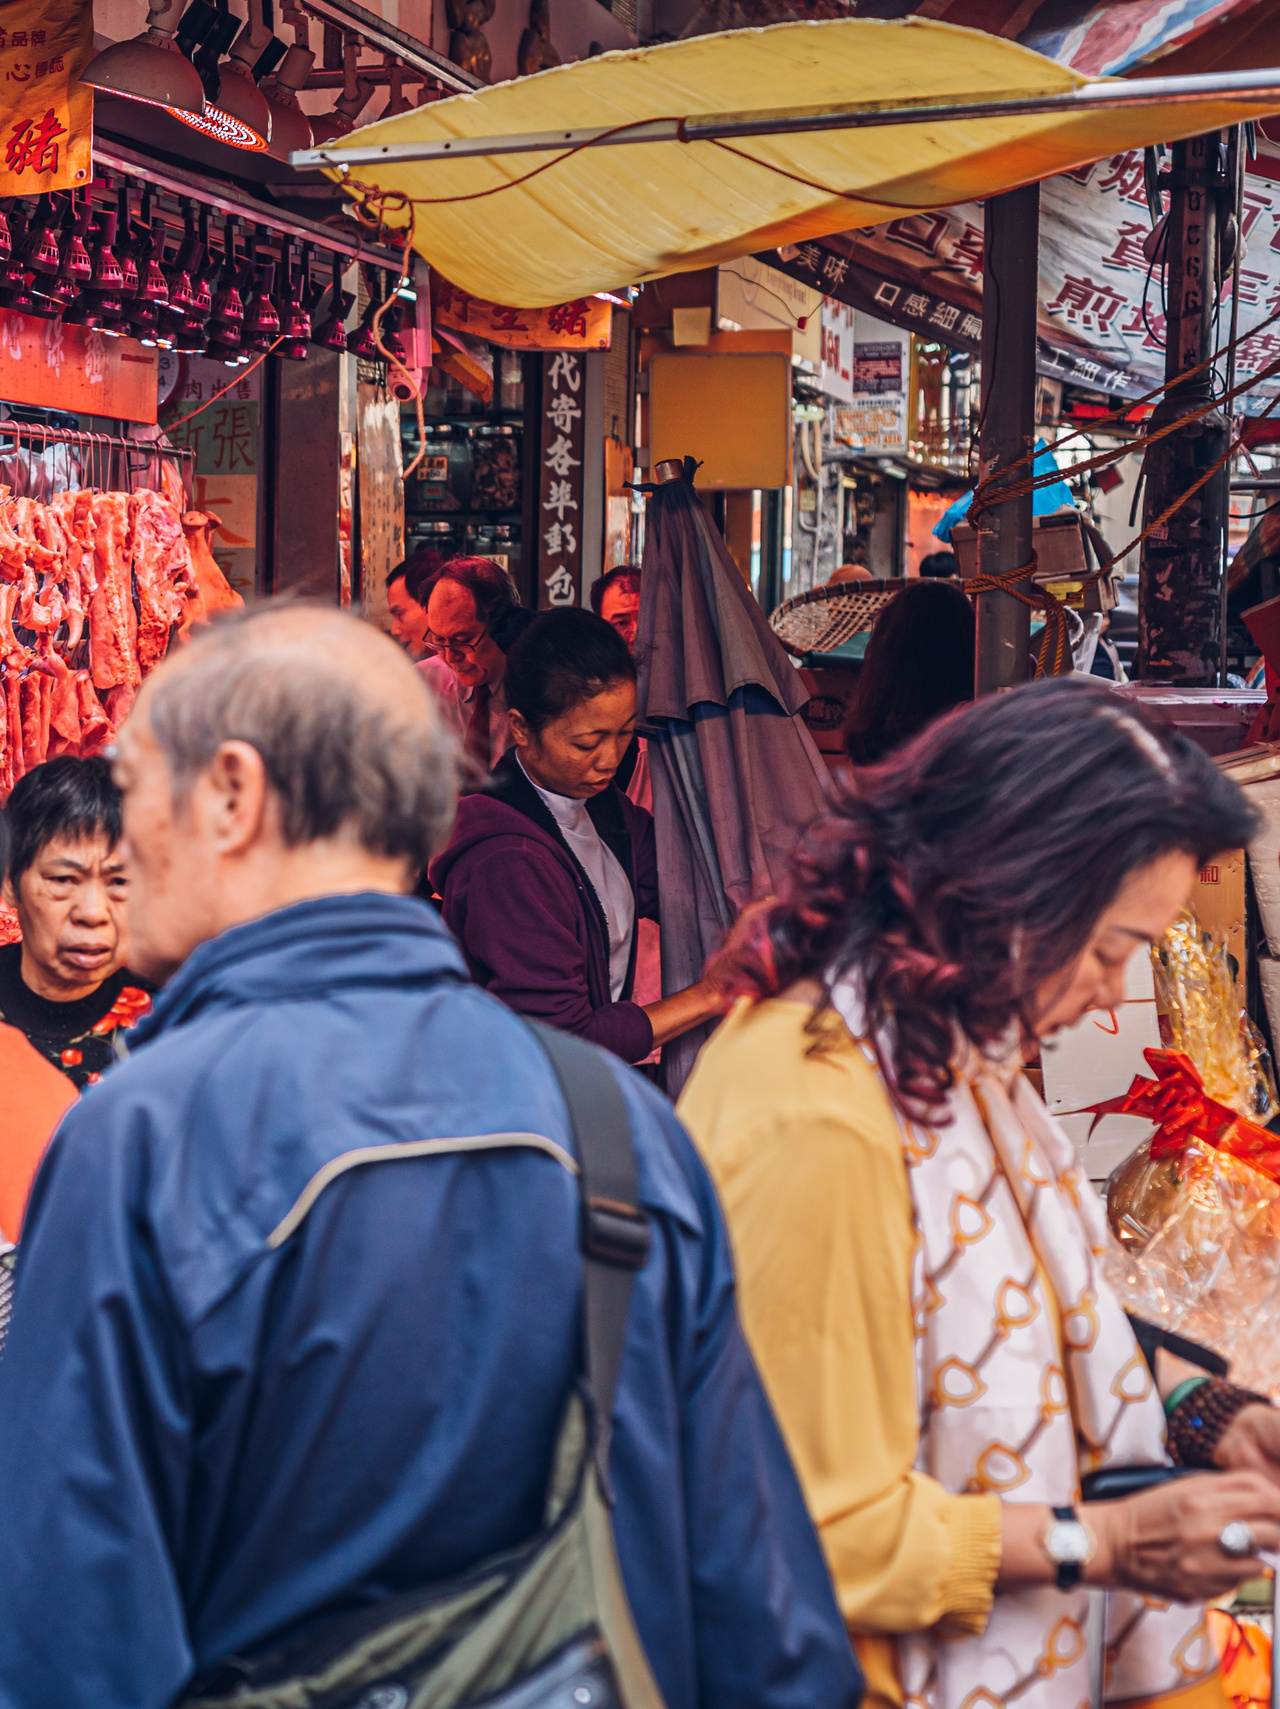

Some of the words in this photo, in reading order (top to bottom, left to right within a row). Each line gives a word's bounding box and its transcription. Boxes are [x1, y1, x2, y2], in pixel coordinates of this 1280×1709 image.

[796, 243, 850, 284] 美味
[1037, 344, 1132, 391] 工細作
